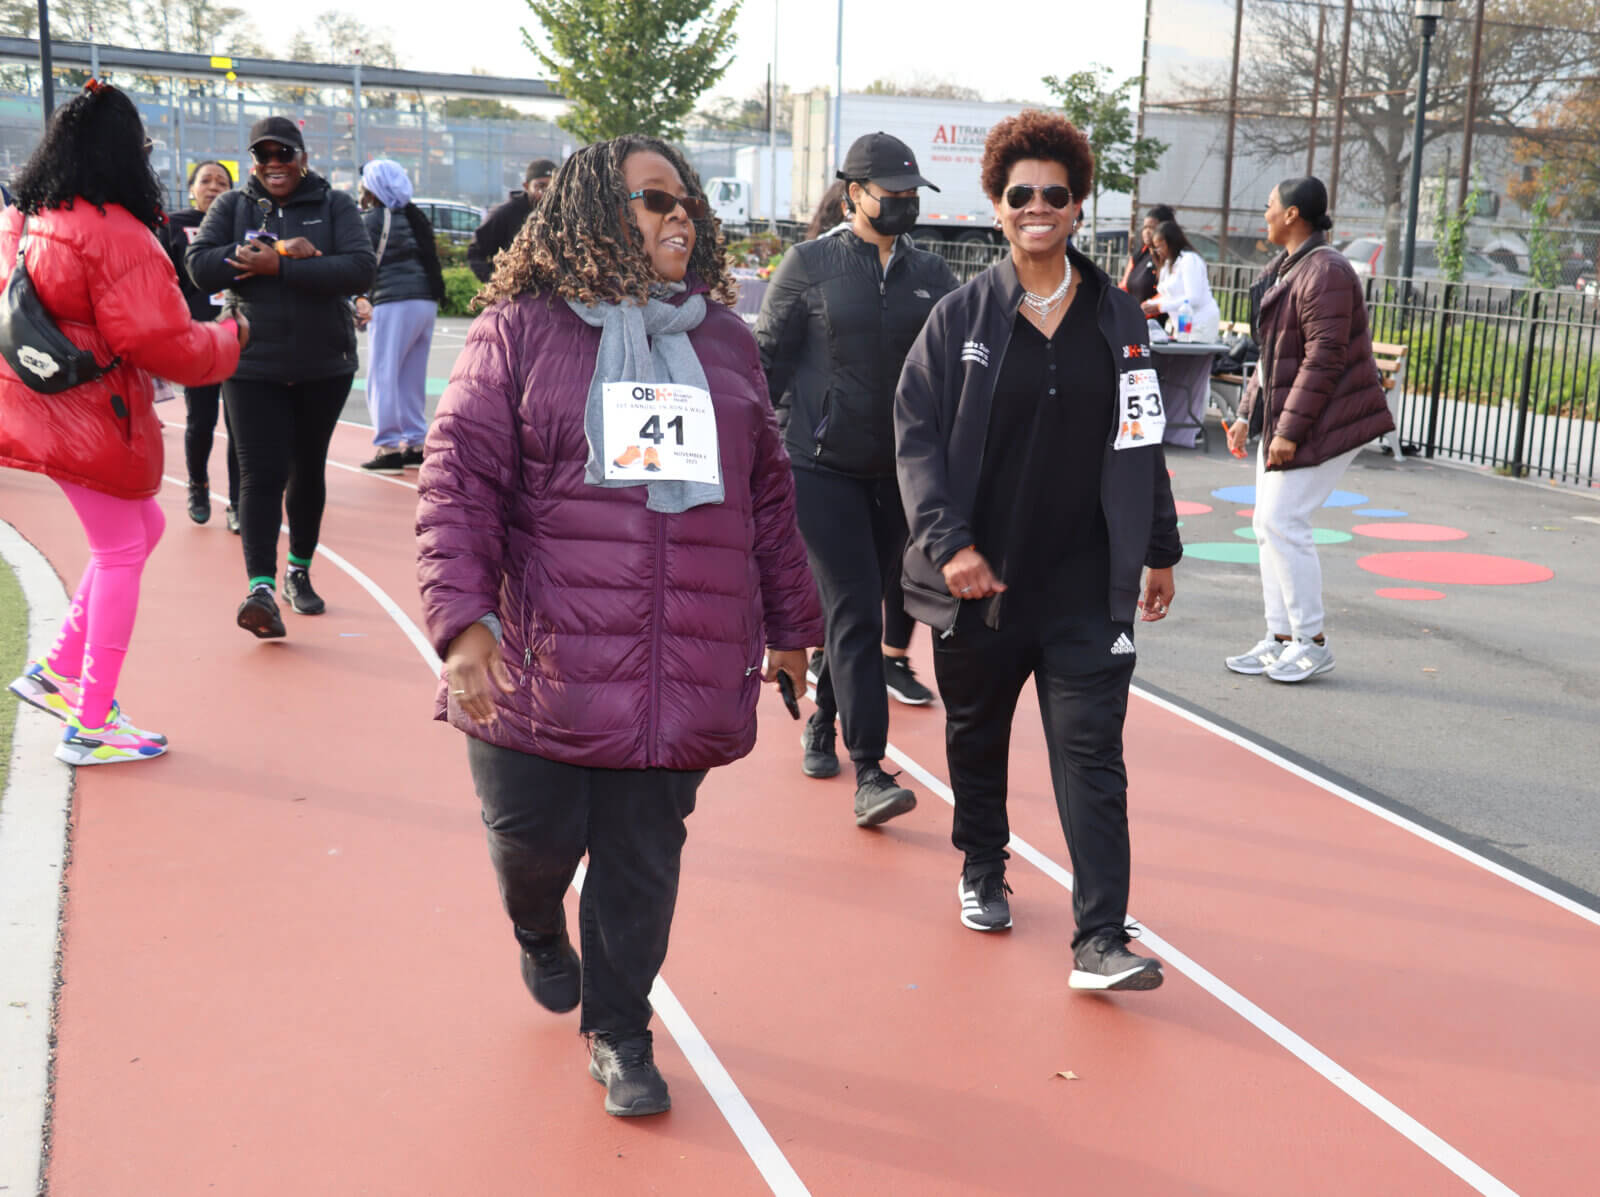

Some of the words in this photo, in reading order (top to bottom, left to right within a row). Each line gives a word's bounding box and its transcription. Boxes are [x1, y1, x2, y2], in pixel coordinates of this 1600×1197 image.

[932, 124, 956, 144] AI
[958, 125, 988, 136] TRAIL
[1127, 393, 1161, 419] 53
[639, 414, 684, 445] 41
